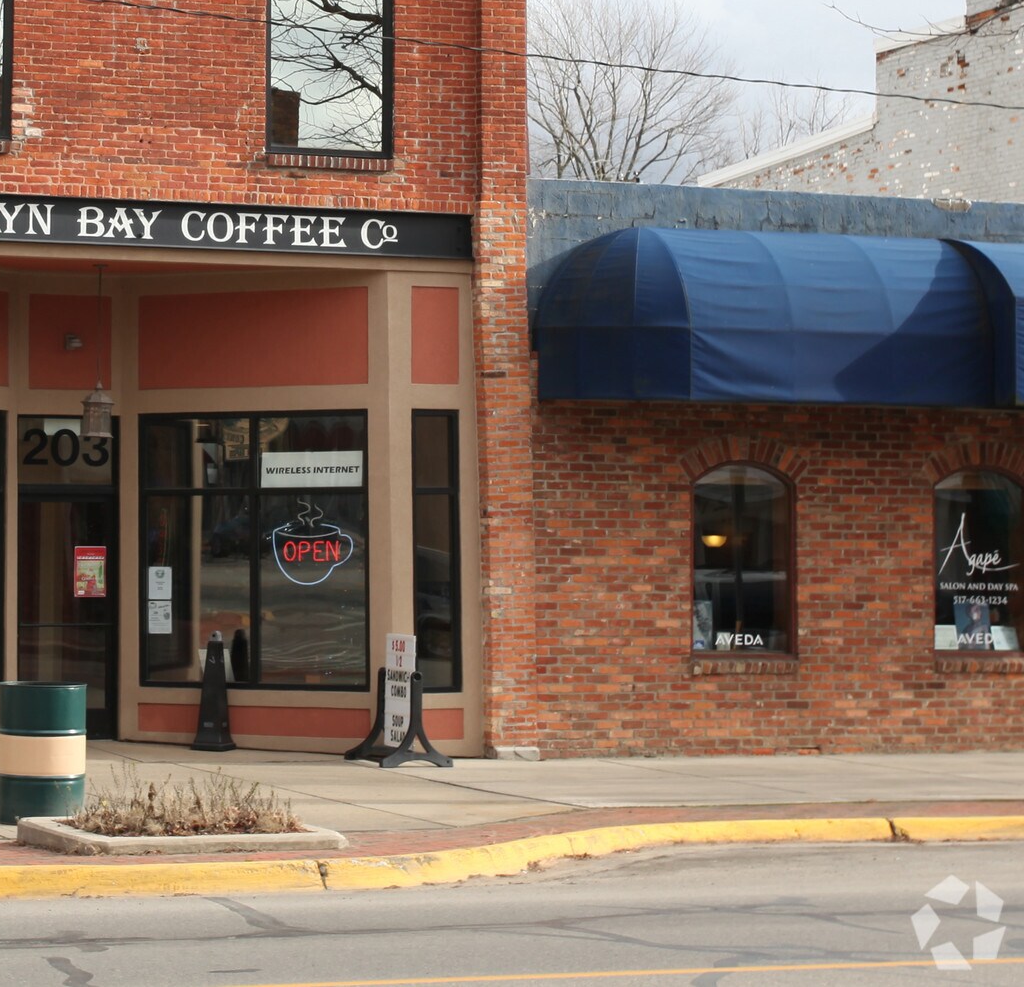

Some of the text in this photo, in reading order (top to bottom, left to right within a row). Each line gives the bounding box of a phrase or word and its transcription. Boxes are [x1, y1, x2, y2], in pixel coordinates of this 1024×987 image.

[77, 206, 163, 240] BAY
[181, 210, 347, 249] COFFEE
[22, 428, 110, 467] 203
[265, 465, 360, 475] WIRELESS INTERNET
[283, 540, 341, 562] OPEN
[939, 582, 1019, 591] SALON AND DAY SPA
[715, 633, 764, 646] AVEDA
[957, 632, 995, 645] AVED
[392, 639, 406, 652] $5.00
[391, 685, 407, 698] COMBO
[392, 714, 404, 727] SOUP
